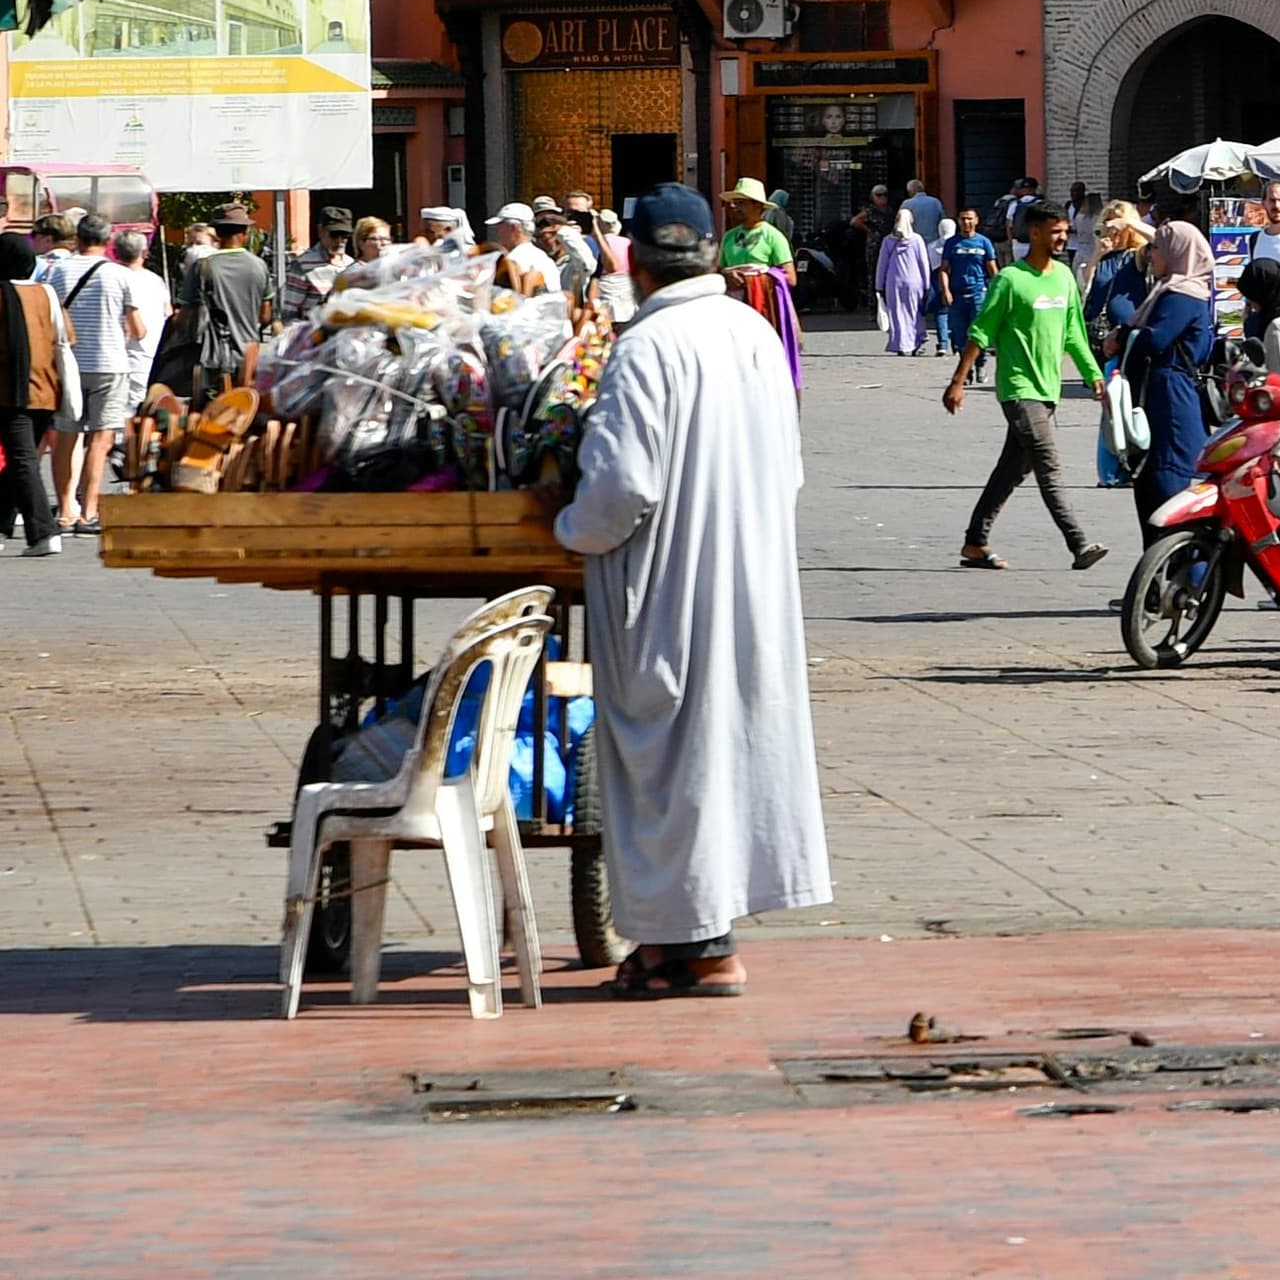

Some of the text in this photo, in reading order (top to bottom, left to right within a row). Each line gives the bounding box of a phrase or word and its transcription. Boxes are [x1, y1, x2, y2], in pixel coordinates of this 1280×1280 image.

[545, 17, 673, 53] ART PLACE
[613, 54, 645, 63] HOTEL
